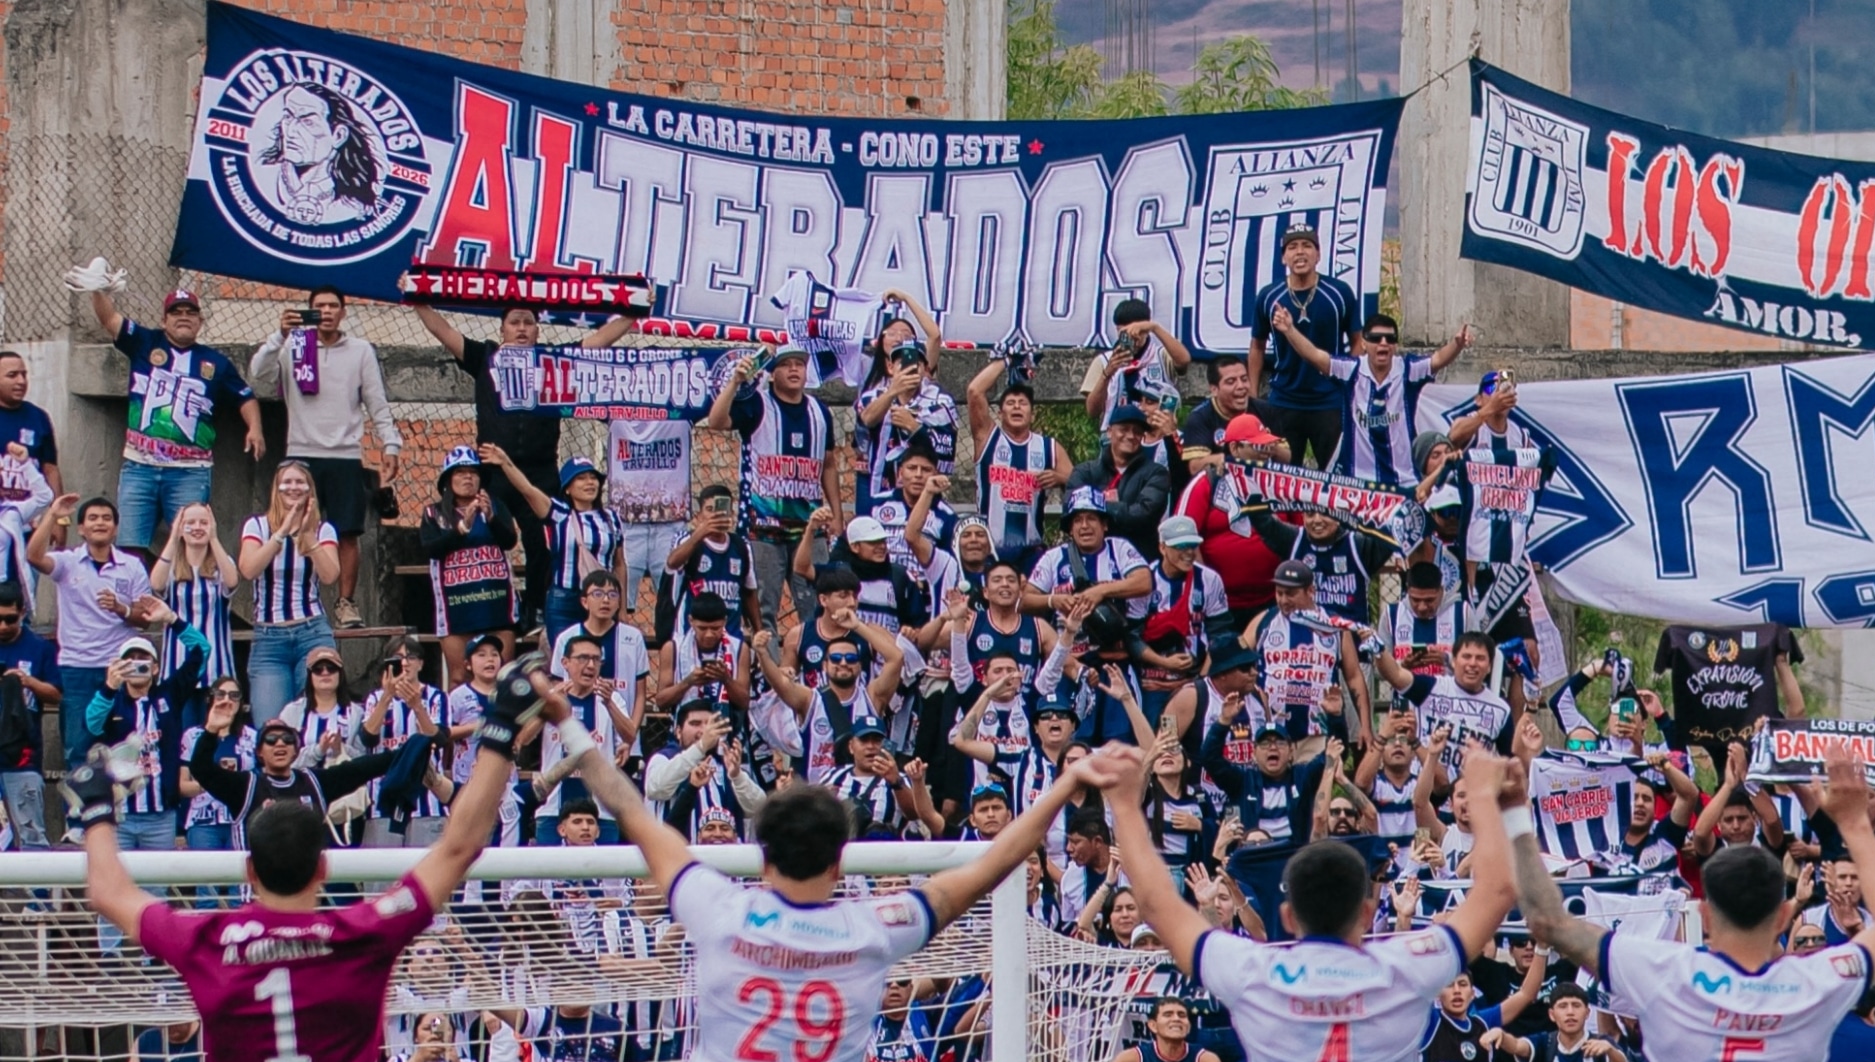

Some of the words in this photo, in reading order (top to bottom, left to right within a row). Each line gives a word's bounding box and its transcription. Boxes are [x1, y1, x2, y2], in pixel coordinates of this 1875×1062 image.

[226, 59, 278, 112] LOS
[274, 55, 420, 152] ALTERADOS
[208, 120, 246, 140] 2011
[606, 101, 650, 135] LA
[654, 109, 835, 165] CARRETERA
[859, 132, 938, 167] CONO
[945, 134, 1021, 165] ESTE
[1229, 142, 1356, 174] ALIANZA
[1481, 128, 1504, 184] CLUB
[391, 164, 428, 185] 2026
[415, 77, 1197, 349] ALTERADOS
[1604, 130, 1744, 278] LOS
[271, 225, 289, 241] DE
[291, 232, 334, 248] TODAS
[334, 230, 361, 248] LAS
[1335, 195, 1358, 280] LIMA
[1508, 217, 1540, 238] 1901
[1203, 207, 1231, 291] CLUB
[441, 271, 603, 304] HERALDOS
[1704, 291, 1861, 347] AMOR,
[565, 347, 612, 363] BARRIO
[639, 347, 682, 362] GRONE
[539, 357, 708, 408] ALTERADOS
[574, 406, 608, 419] ALTO
[617, 438, 682, 462] ALTERADOS
[757, 456, 796, 476] SANTO
[1265, 650, 1336, 667] CORRALITO
[1272, 669, 1327, 685] GRONE
[1810, 719, 1836, 732] LOS
[1838, 720, 1855, 732] DE
[1541, 793, 1565, 813] SAN
[1565, 786, 1615, 808] GABRIEL
[1713, 1008, 1783, 1032] PAVEZ
